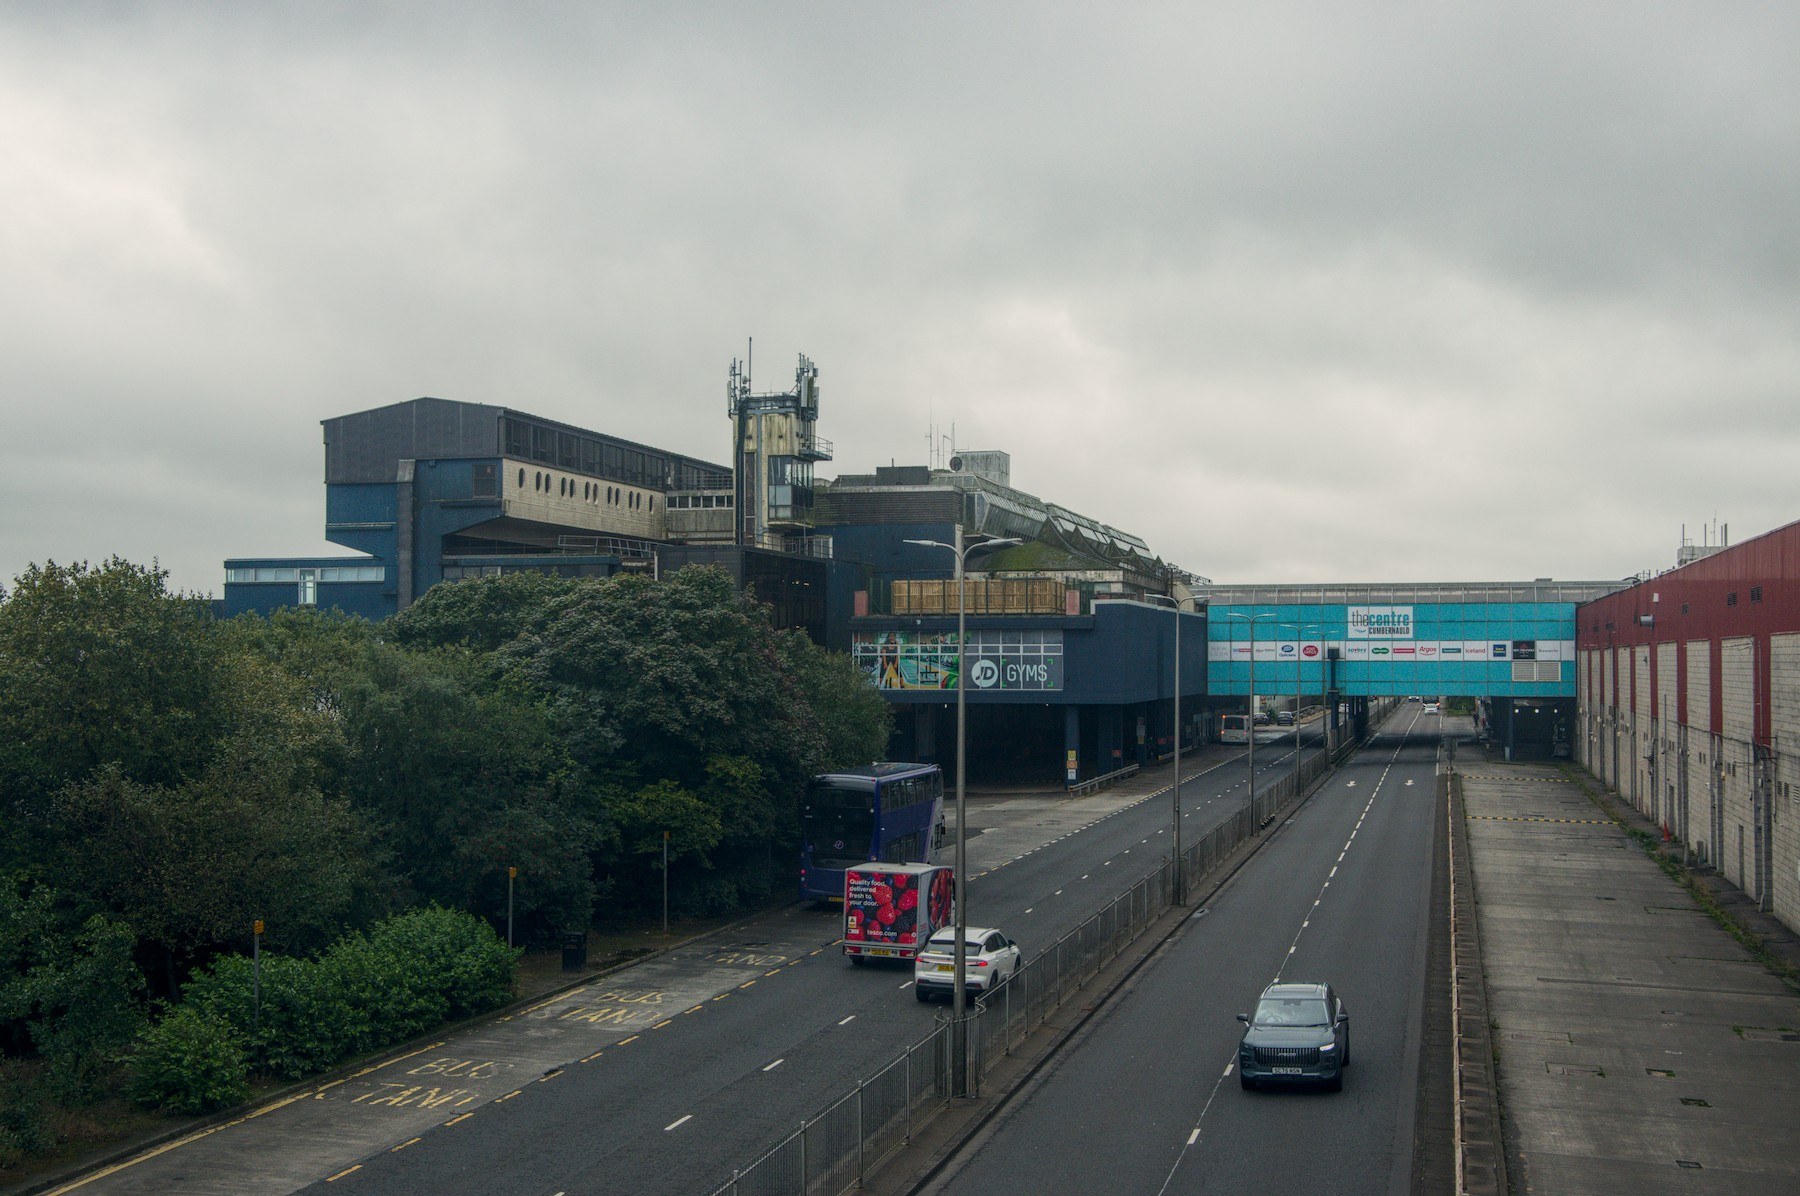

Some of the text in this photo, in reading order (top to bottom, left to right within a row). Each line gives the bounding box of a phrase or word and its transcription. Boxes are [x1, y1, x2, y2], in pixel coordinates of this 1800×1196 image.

[1369, 627, 1410, 635] CUMBERNAULD
[1006, 664, 1048, 682] GYMS
[849, 878, 870, 886] Quality
[406, 1058, 515, 1079] BUS
